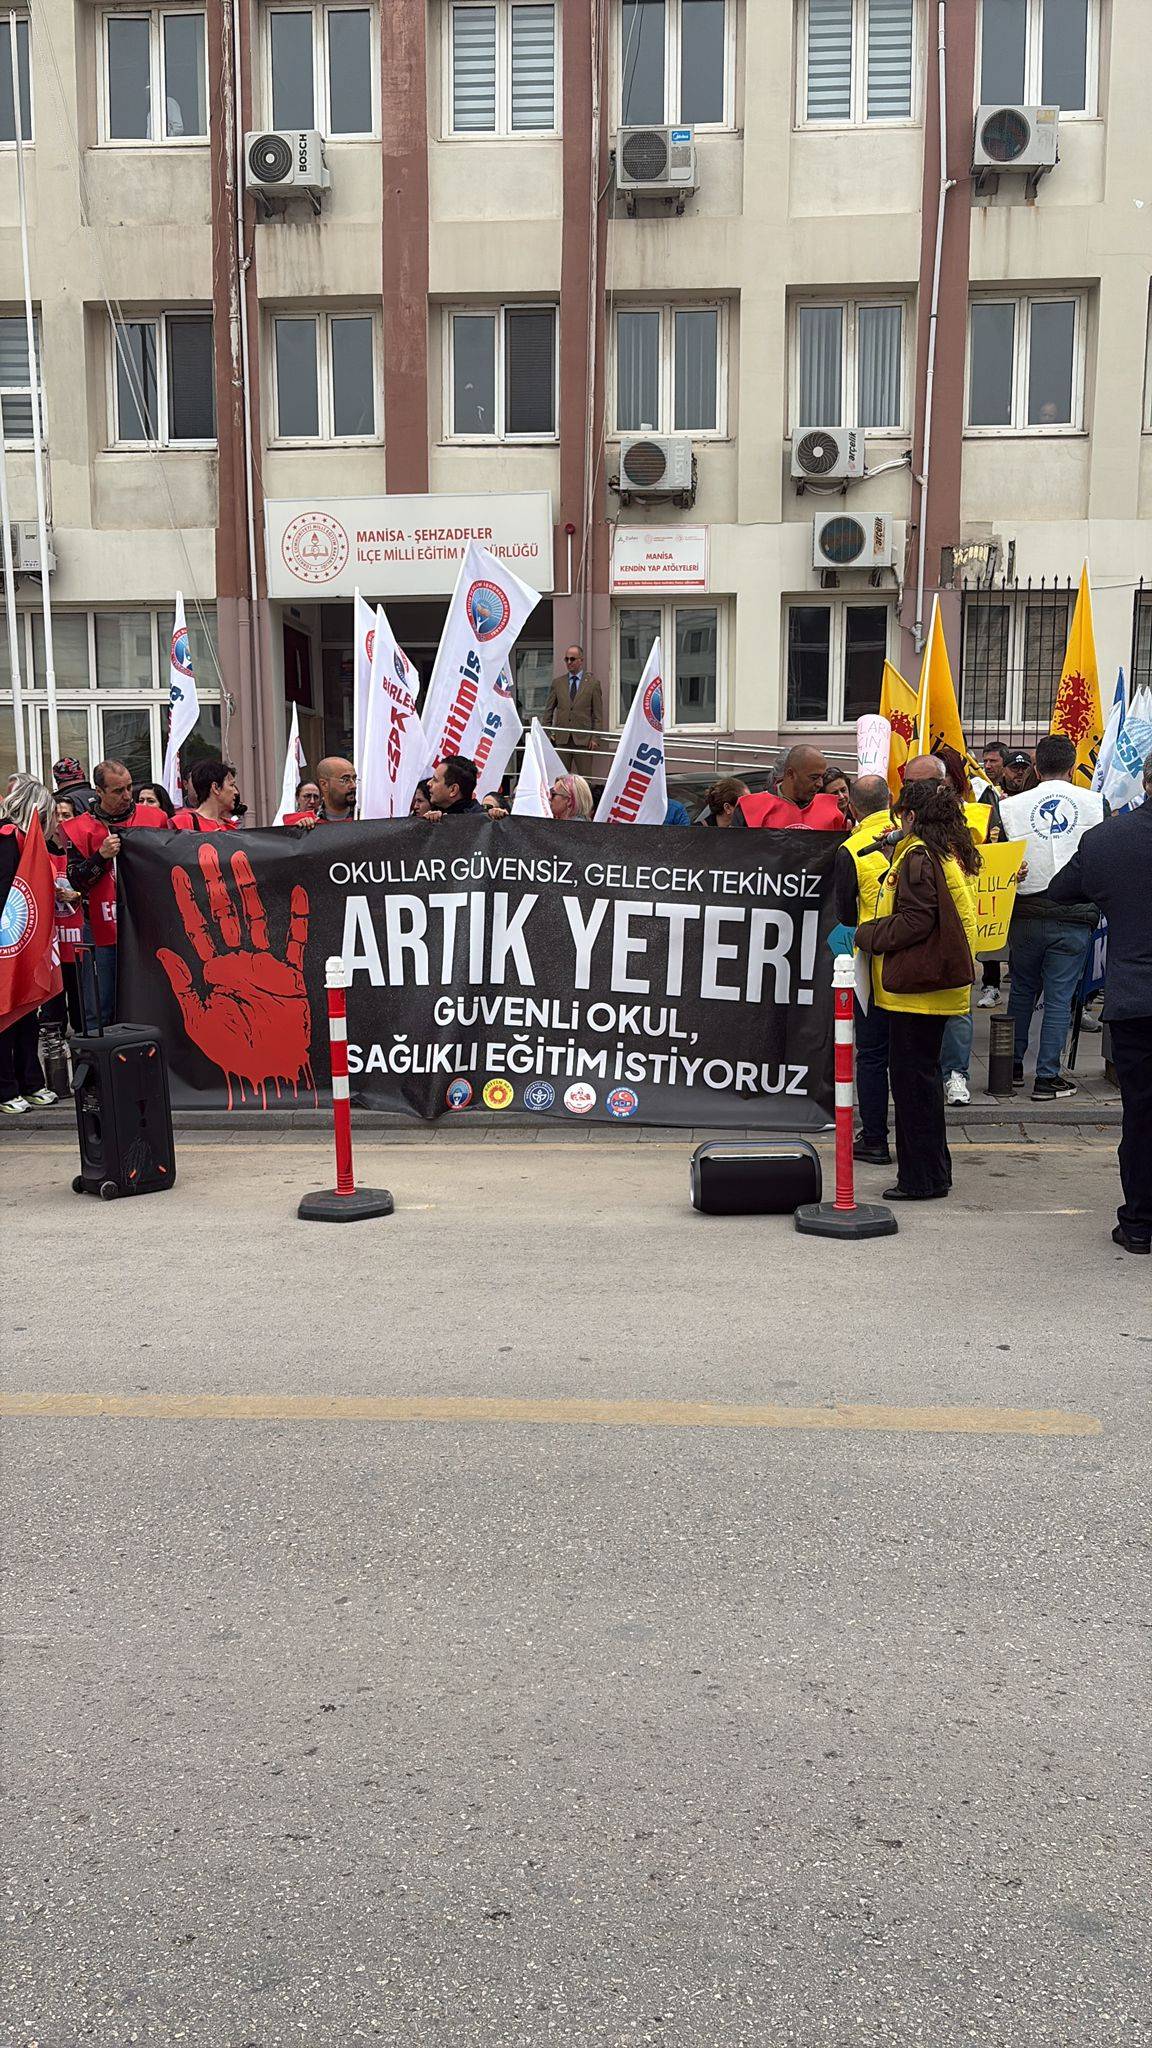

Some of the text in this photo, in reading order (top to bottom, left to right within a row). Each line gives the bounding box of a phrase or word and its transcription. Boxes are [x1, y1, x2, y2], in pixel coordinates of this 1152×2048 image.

[299, 134, 307, 172] BOSCH
[848, 431, 857, 462] arçelik
[356, 527, 405, 543] MANİSA
[414, 527, 493, 545] ŞEHZADELER
[356, 542, 539, 565] İLÇE MİLLİ EĞİTİM ÜRLÜĞÜ
[619, 564, 646, 572] KENDİN
[662, 563, 699, 572] ATÖLYELERİ
[645, 551, 674, 560] MANİSA
[387, 705, 411, 784] KAMU
[329, 851, 822, 898] OKULLAR GÜVENSİZ, GELECEK TEKİNSİZ
[341, 891, 819, 1005] ARTIK YETER!
[434, 996, 698, 1045] GÜVENLİ OKUL,
[346, 1034, 809, 1096] SAĞLIKLI EĞİTİM İSTİYORUZ
